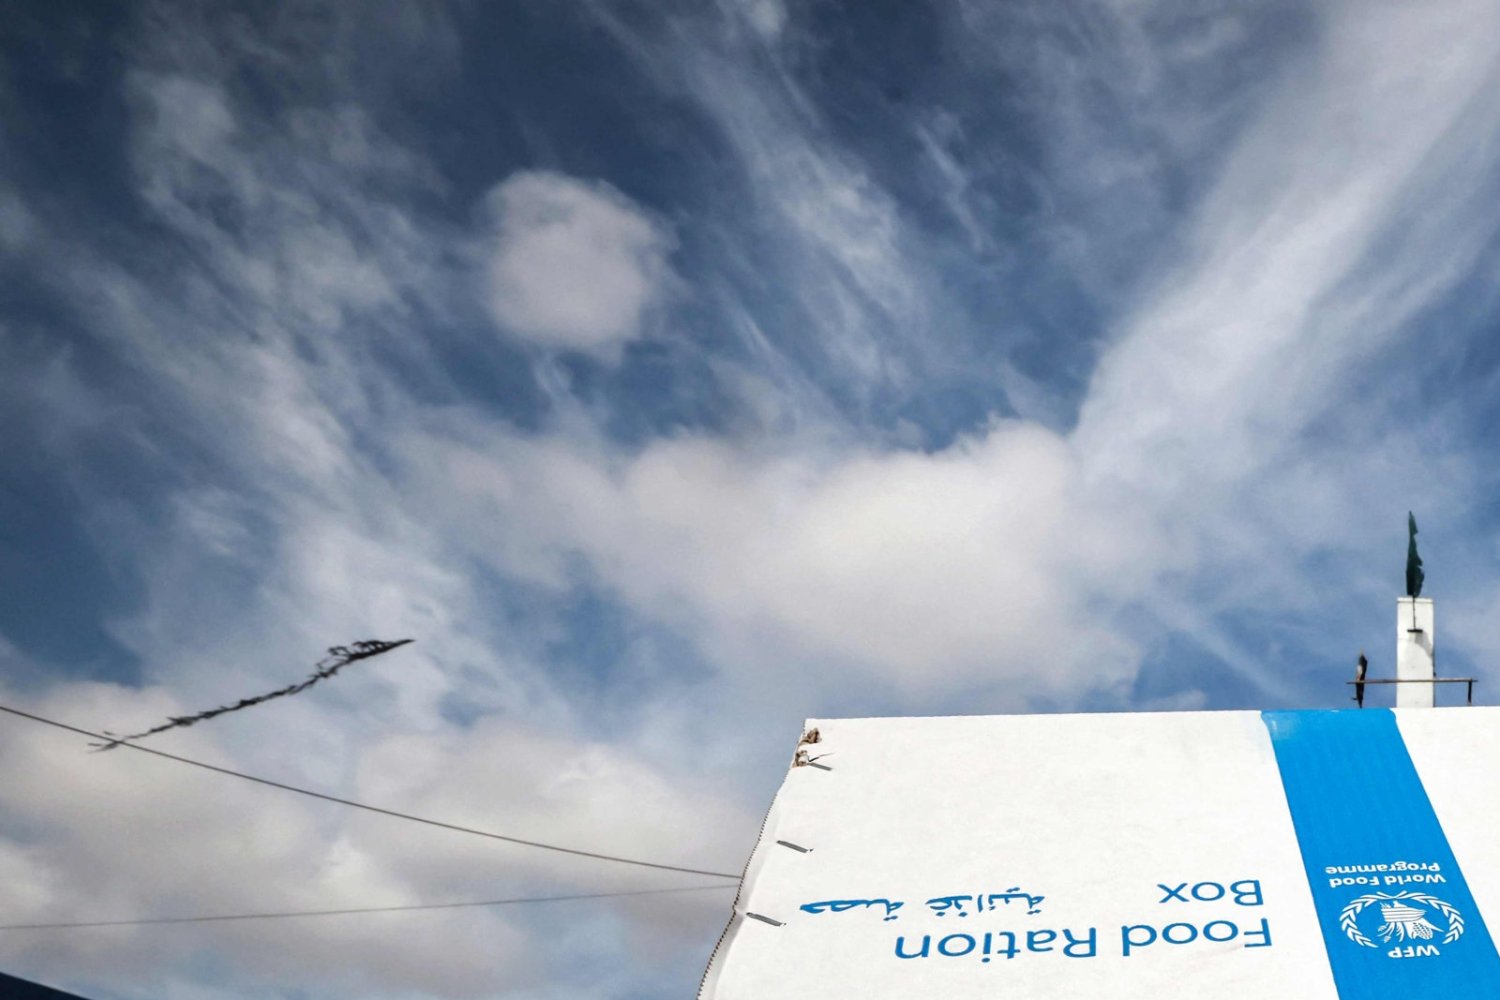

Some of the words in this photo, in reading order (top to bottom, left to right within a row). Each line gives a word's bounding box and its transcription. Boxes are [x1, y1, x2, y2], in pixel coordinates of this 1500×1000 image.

[1325, 860, 1441, 875] Programme
[1329, 876, 1380, 888] Food
[1383, 873, 1447, 886] World
[1157, 879, 1265, 907] Box
[799, 898, 905, 922] حصة
[925, 886, 1046, 917] غذائية
[894, 926, 1097, 963] Ration
[1120, 917, 1273, 957] Food
[1387, 944, 1441, 959] WFP
